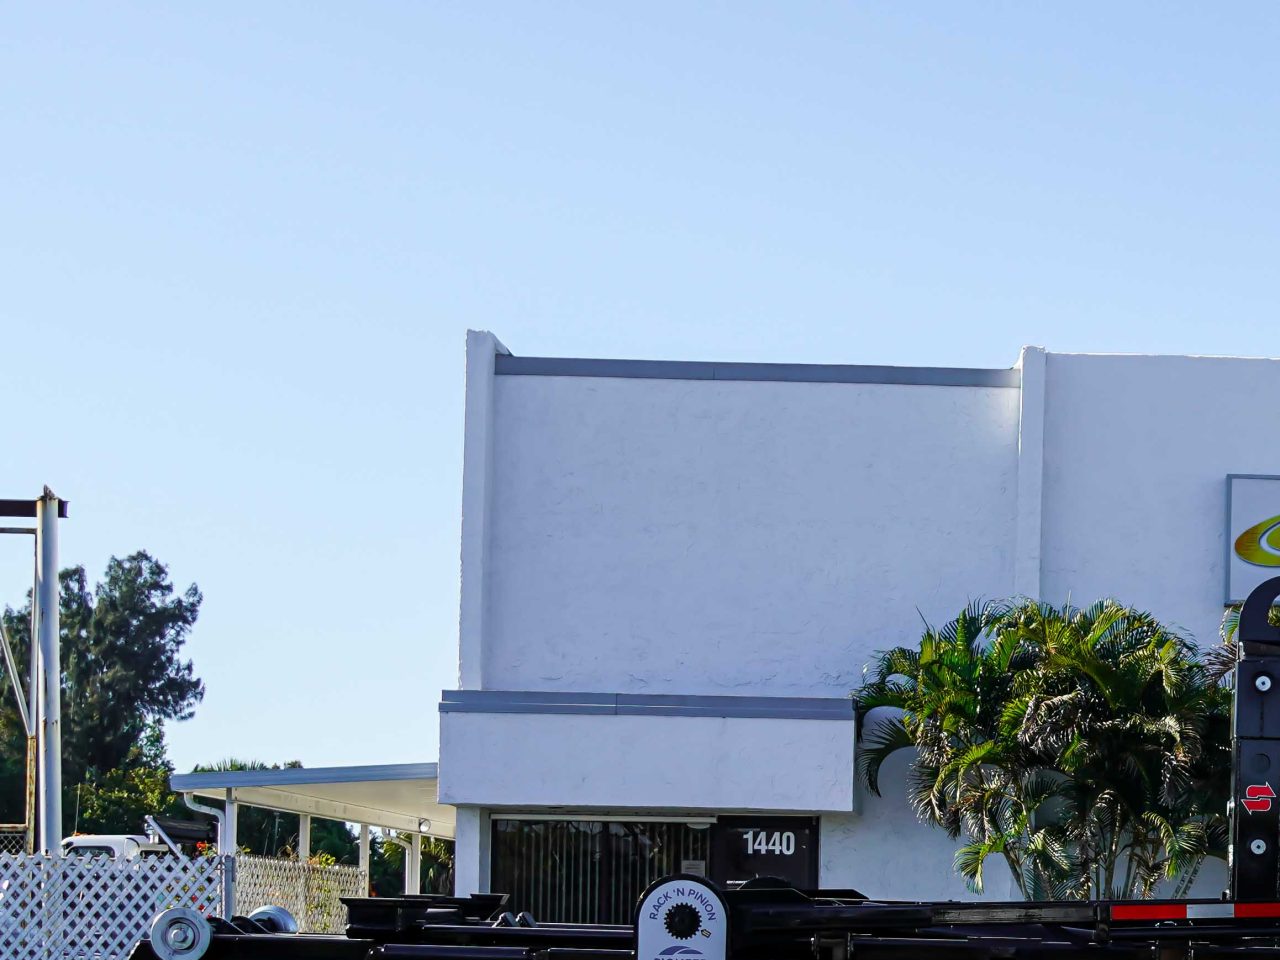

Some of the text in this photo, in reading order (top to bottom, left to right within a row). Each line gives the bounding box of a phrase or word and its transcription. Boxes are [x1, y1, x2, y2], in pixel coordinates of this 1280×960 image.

[742, 830, 795, 855] 1440
[649, 891, 672, 920] RACK
[688, 888, 717, 921] PINION
